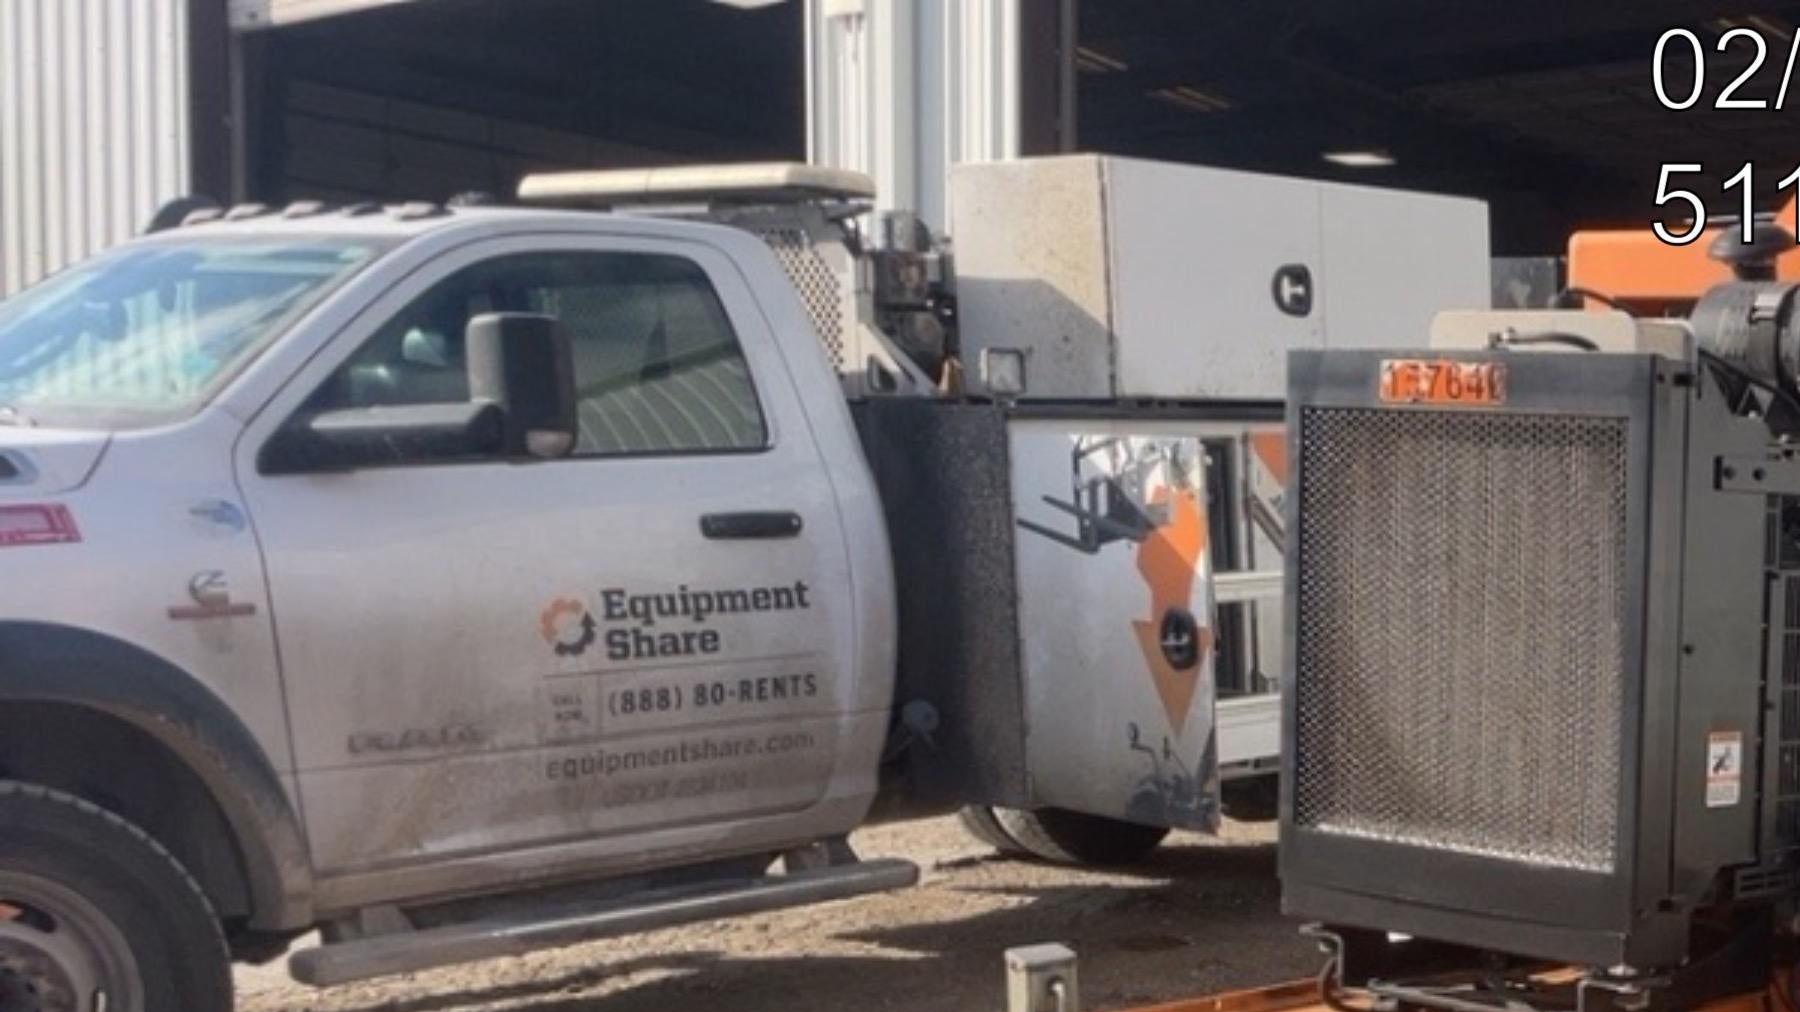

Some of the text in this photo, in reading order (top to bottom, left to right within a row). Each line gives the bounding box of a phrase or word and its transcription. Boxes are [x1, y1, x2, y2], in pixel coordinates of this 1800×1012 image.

[602, 580, 810, 626] Equipment
[605, 628, 720, 661] Share
[608, 673, 818, 716] (888) 80-RENTS
[545, 731, 814, 779] equipmentshare.com
